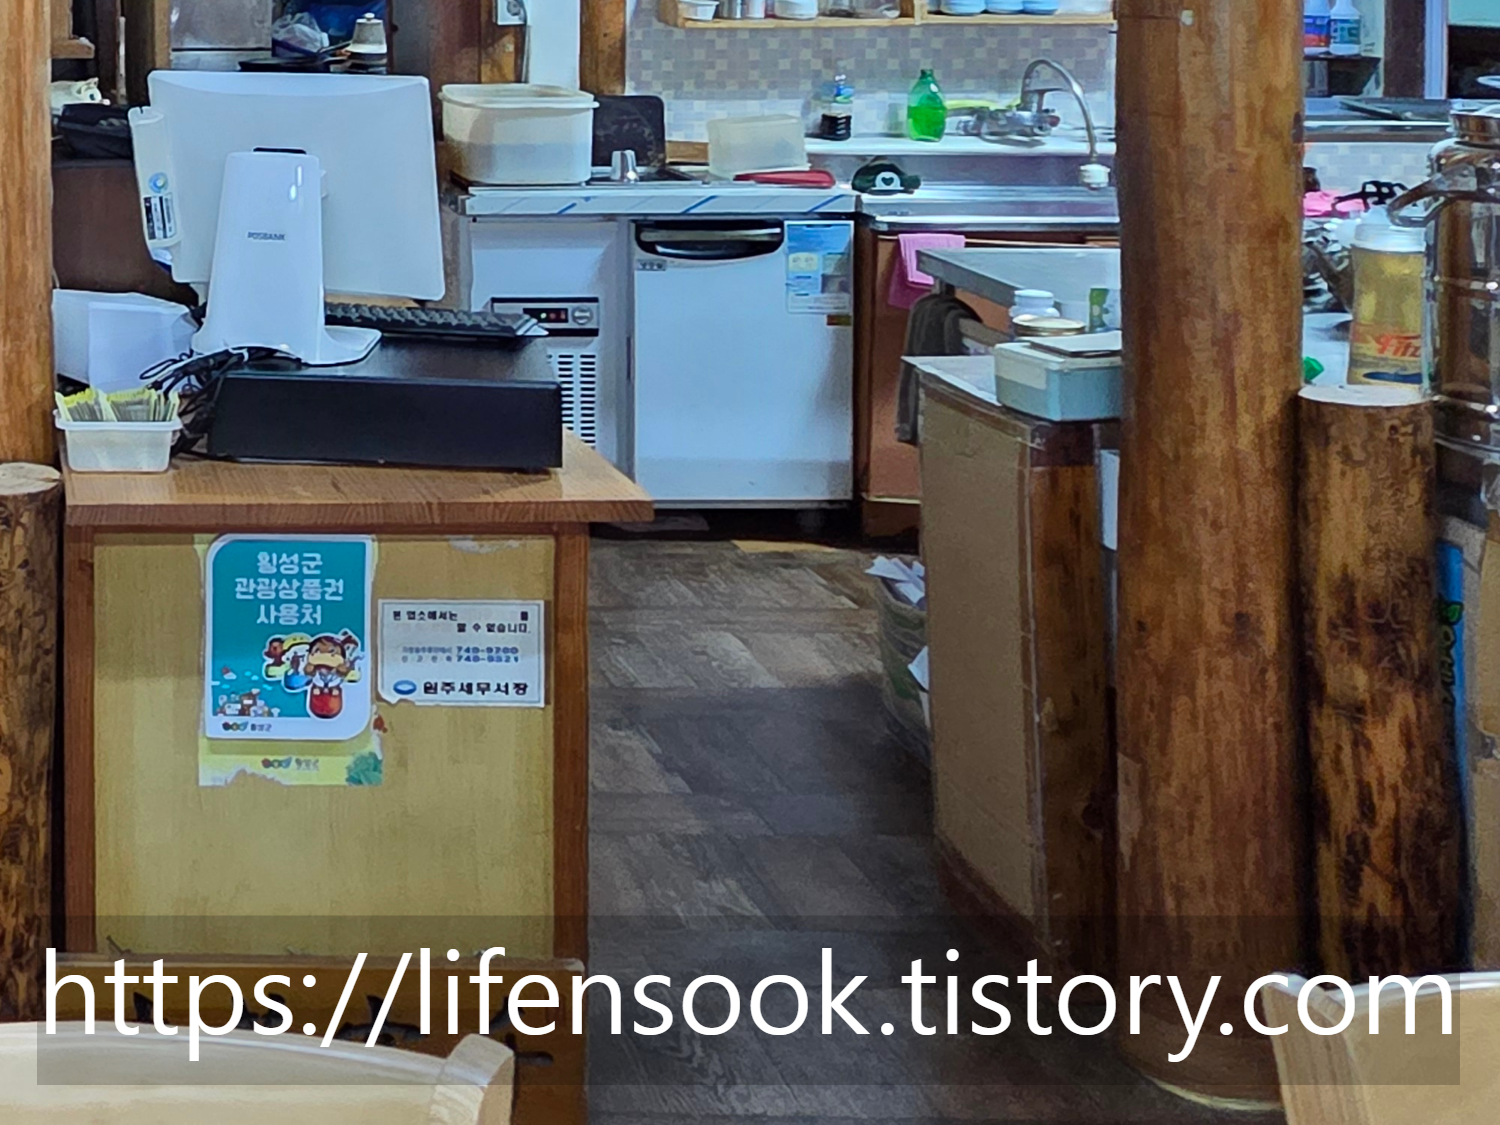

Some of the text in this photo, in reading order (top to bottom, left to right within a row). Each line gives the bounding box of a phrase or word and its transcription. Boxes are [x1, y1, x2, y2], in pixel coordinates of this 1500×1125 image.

[256, 551, 323, 575] 횡성군
[234, 577, 345, 601] 관광상품권
[256, 603, 322, 625] 사용처
[423, 681, 529, 696] 원주세무서장
